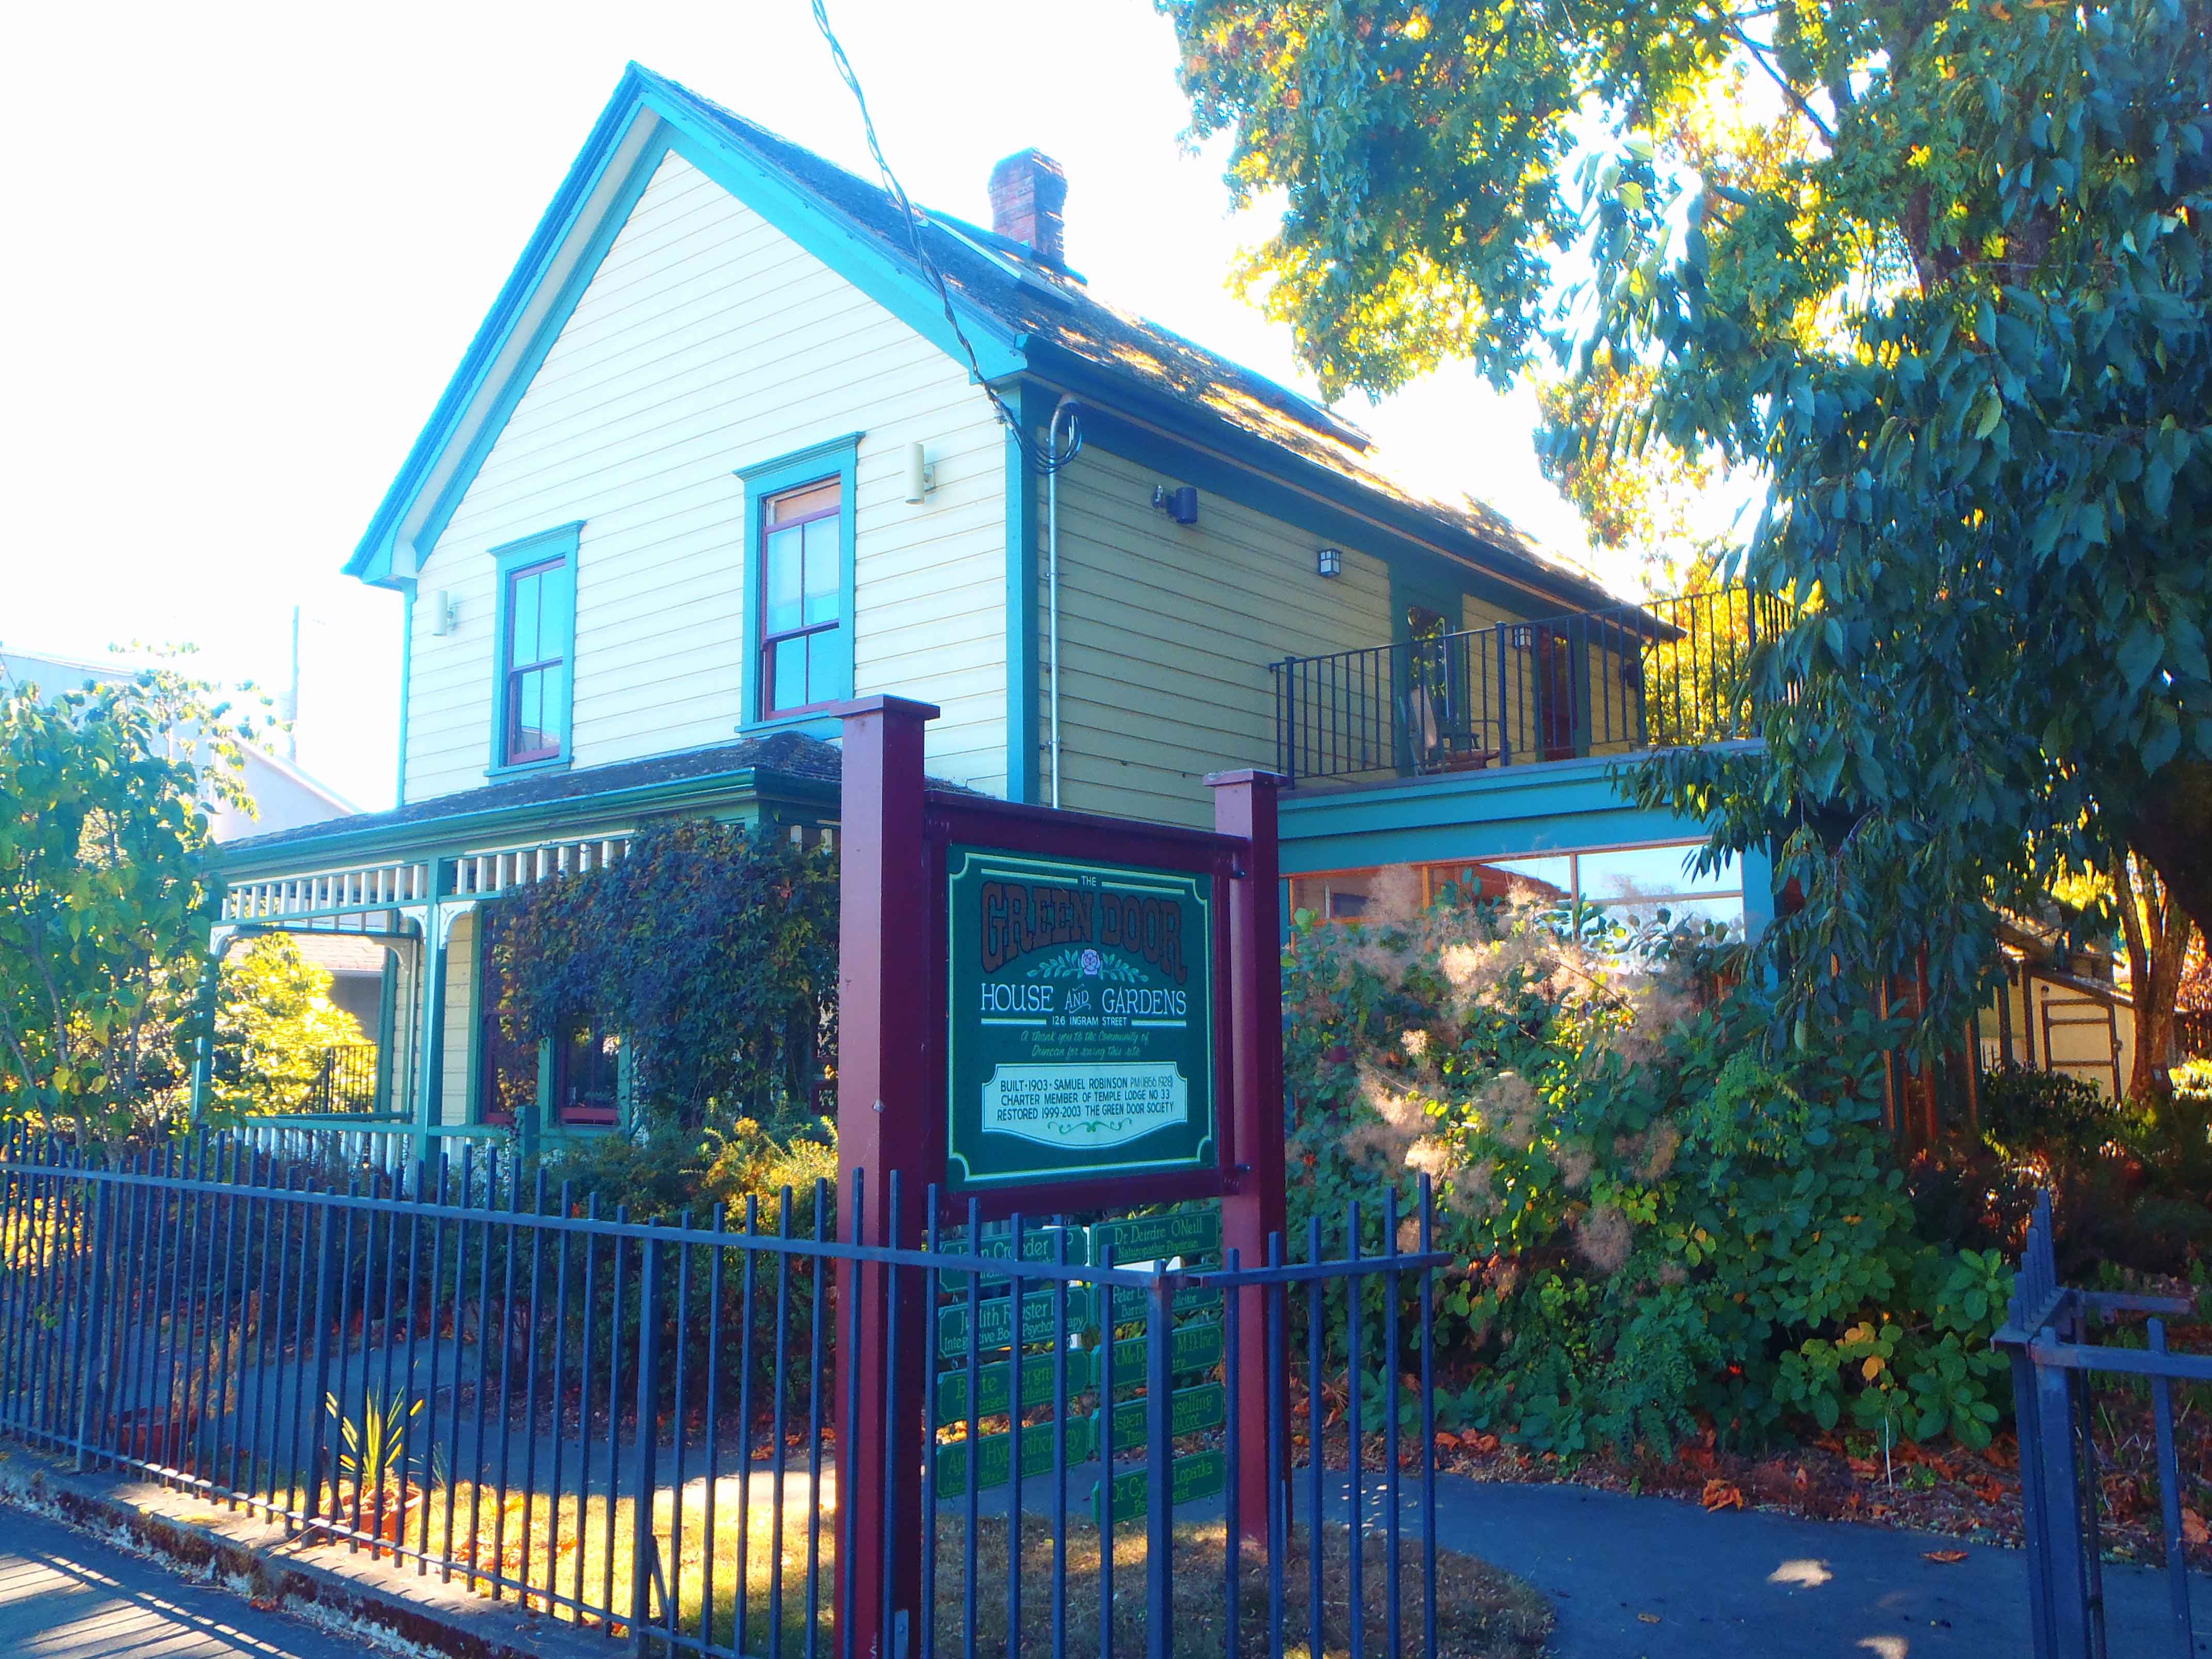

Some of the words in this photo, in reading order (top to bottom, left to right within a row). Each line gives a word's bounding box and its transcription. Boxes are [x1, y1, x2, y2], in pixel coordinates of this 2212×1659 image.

[1081, 875, 1097, 887] THE
[981, 880, 1094, 973] GREEN
[1100, 892, 1188, 985] DOOR
[981, 983, 1054, 1011] HOUSE
[1065, 985, 1090, 1013] AND
[1102, 986, 1186, 1015] GARDENS
[1052, 1016, 1065, 1026] 126
[1069, 1016, 1098, 1026] INGRAM
[1102, 1016, 1127, 1027] STREET
[1058, 1032, 1072, 1044] you
[1074, 1031, 1082, 1041] to
[1141, 1031, 1150, 1045] of
[1031, 1044, 1065, 1056] Duncan
[1065, 1045, 1078, 1060] for
[1054, 1078, 1085, 1090] SAMUEL
[1089, 1077, 1128, 1089] ROBINSON
[1001, 1093, 1040, 1106] CHARTER
[1044, 1092, 1078, 1104] MEMBER
[1082, 1092, 1092, 1102] OF
[1094, 1090, 1121, 1102] TEMPLE
[1125, 1089, 1146, 1100] LODGE
[1149, 1089, 1158, 1099] NO
[1161, 1089, 1170, 1099] 33
[997, 1107, 1038, 1121] RESTORED
[1085, 1104, 1100, 1116] THE
[1102, 1103, 1124, 1115] GREEN
[1126, 1102, 1144, 1114] DOOR
[1146, 1101, 1174, 1113] SOCIETY
[1131, 1224, 1166, 1243] Deirdre
